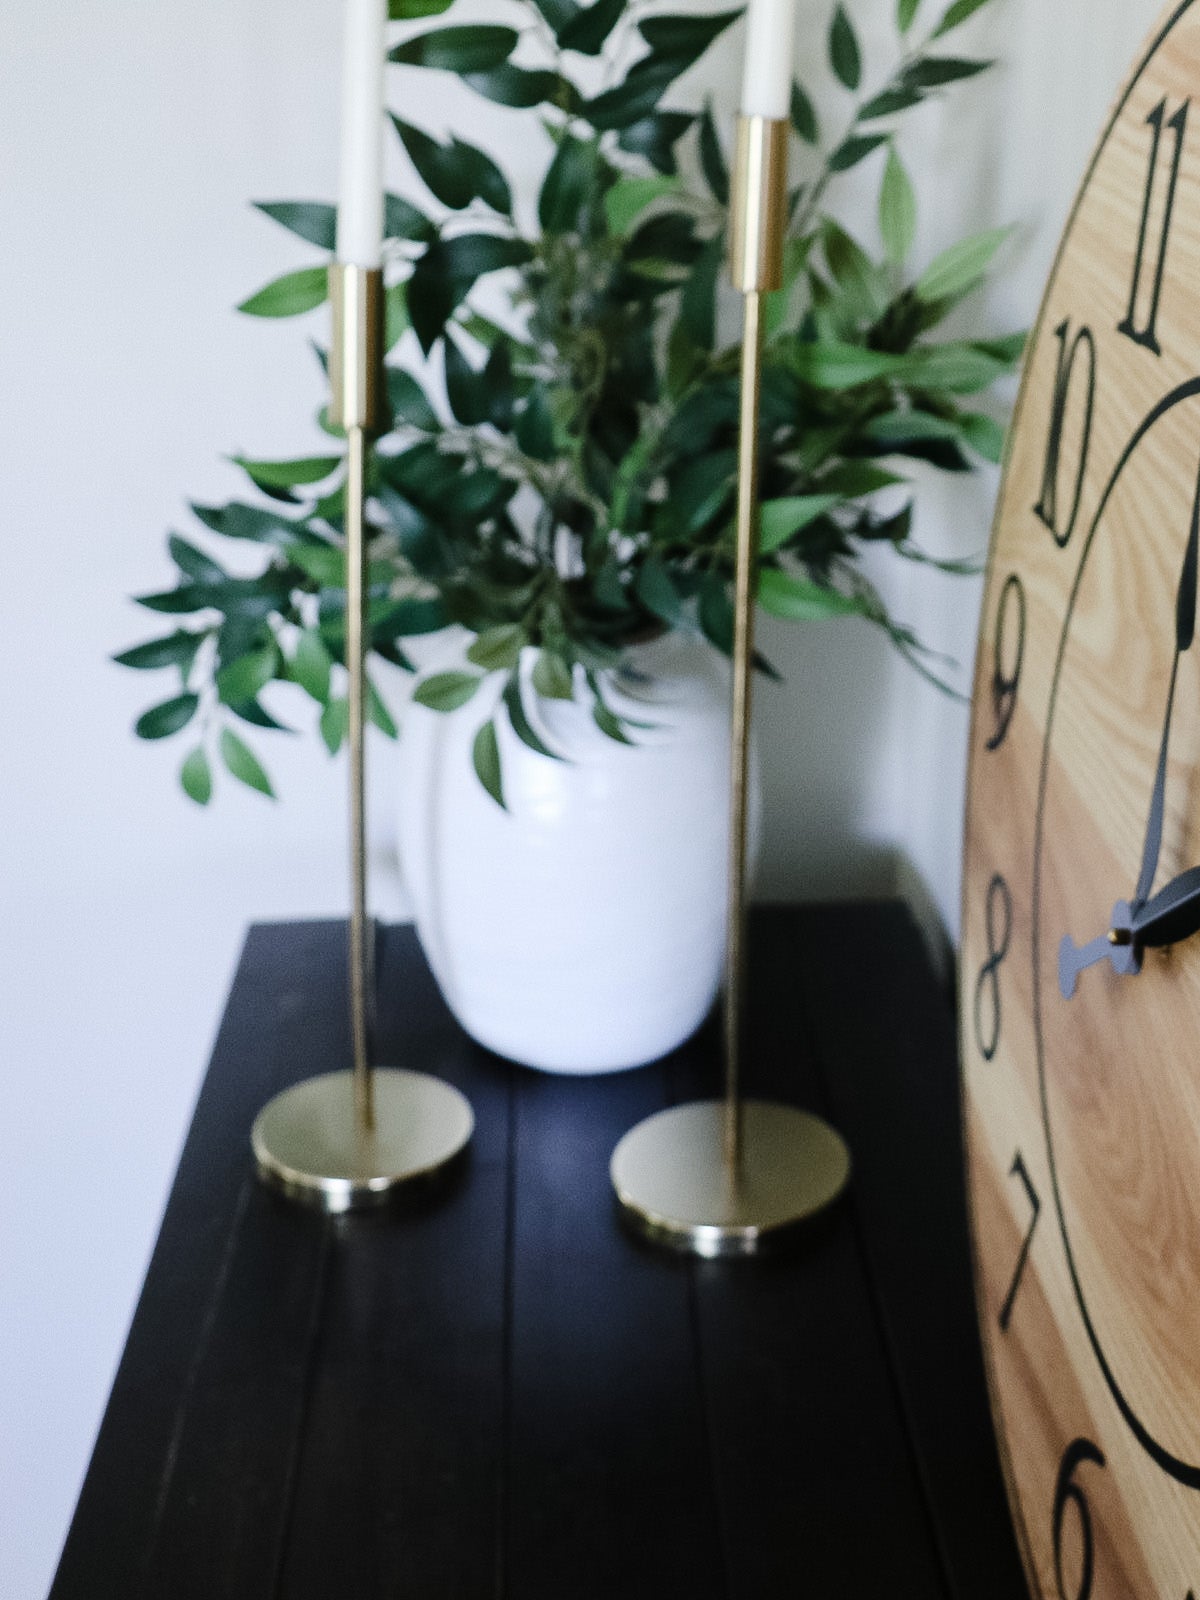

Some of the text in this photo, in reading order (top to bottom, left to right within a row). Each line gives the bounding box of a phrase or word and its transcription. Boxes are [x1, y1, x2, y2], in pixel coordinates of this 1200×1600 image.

[1116, 95, 1190, 357] 11
[1033, 315, 1097, 549] 10
[986, 573, 1027, 751] 9
[974, 873, 1012, 1061] 8
[1001, 1146, 1042, 1333] 7
[1052, 1437, 1106, 1600] 6
